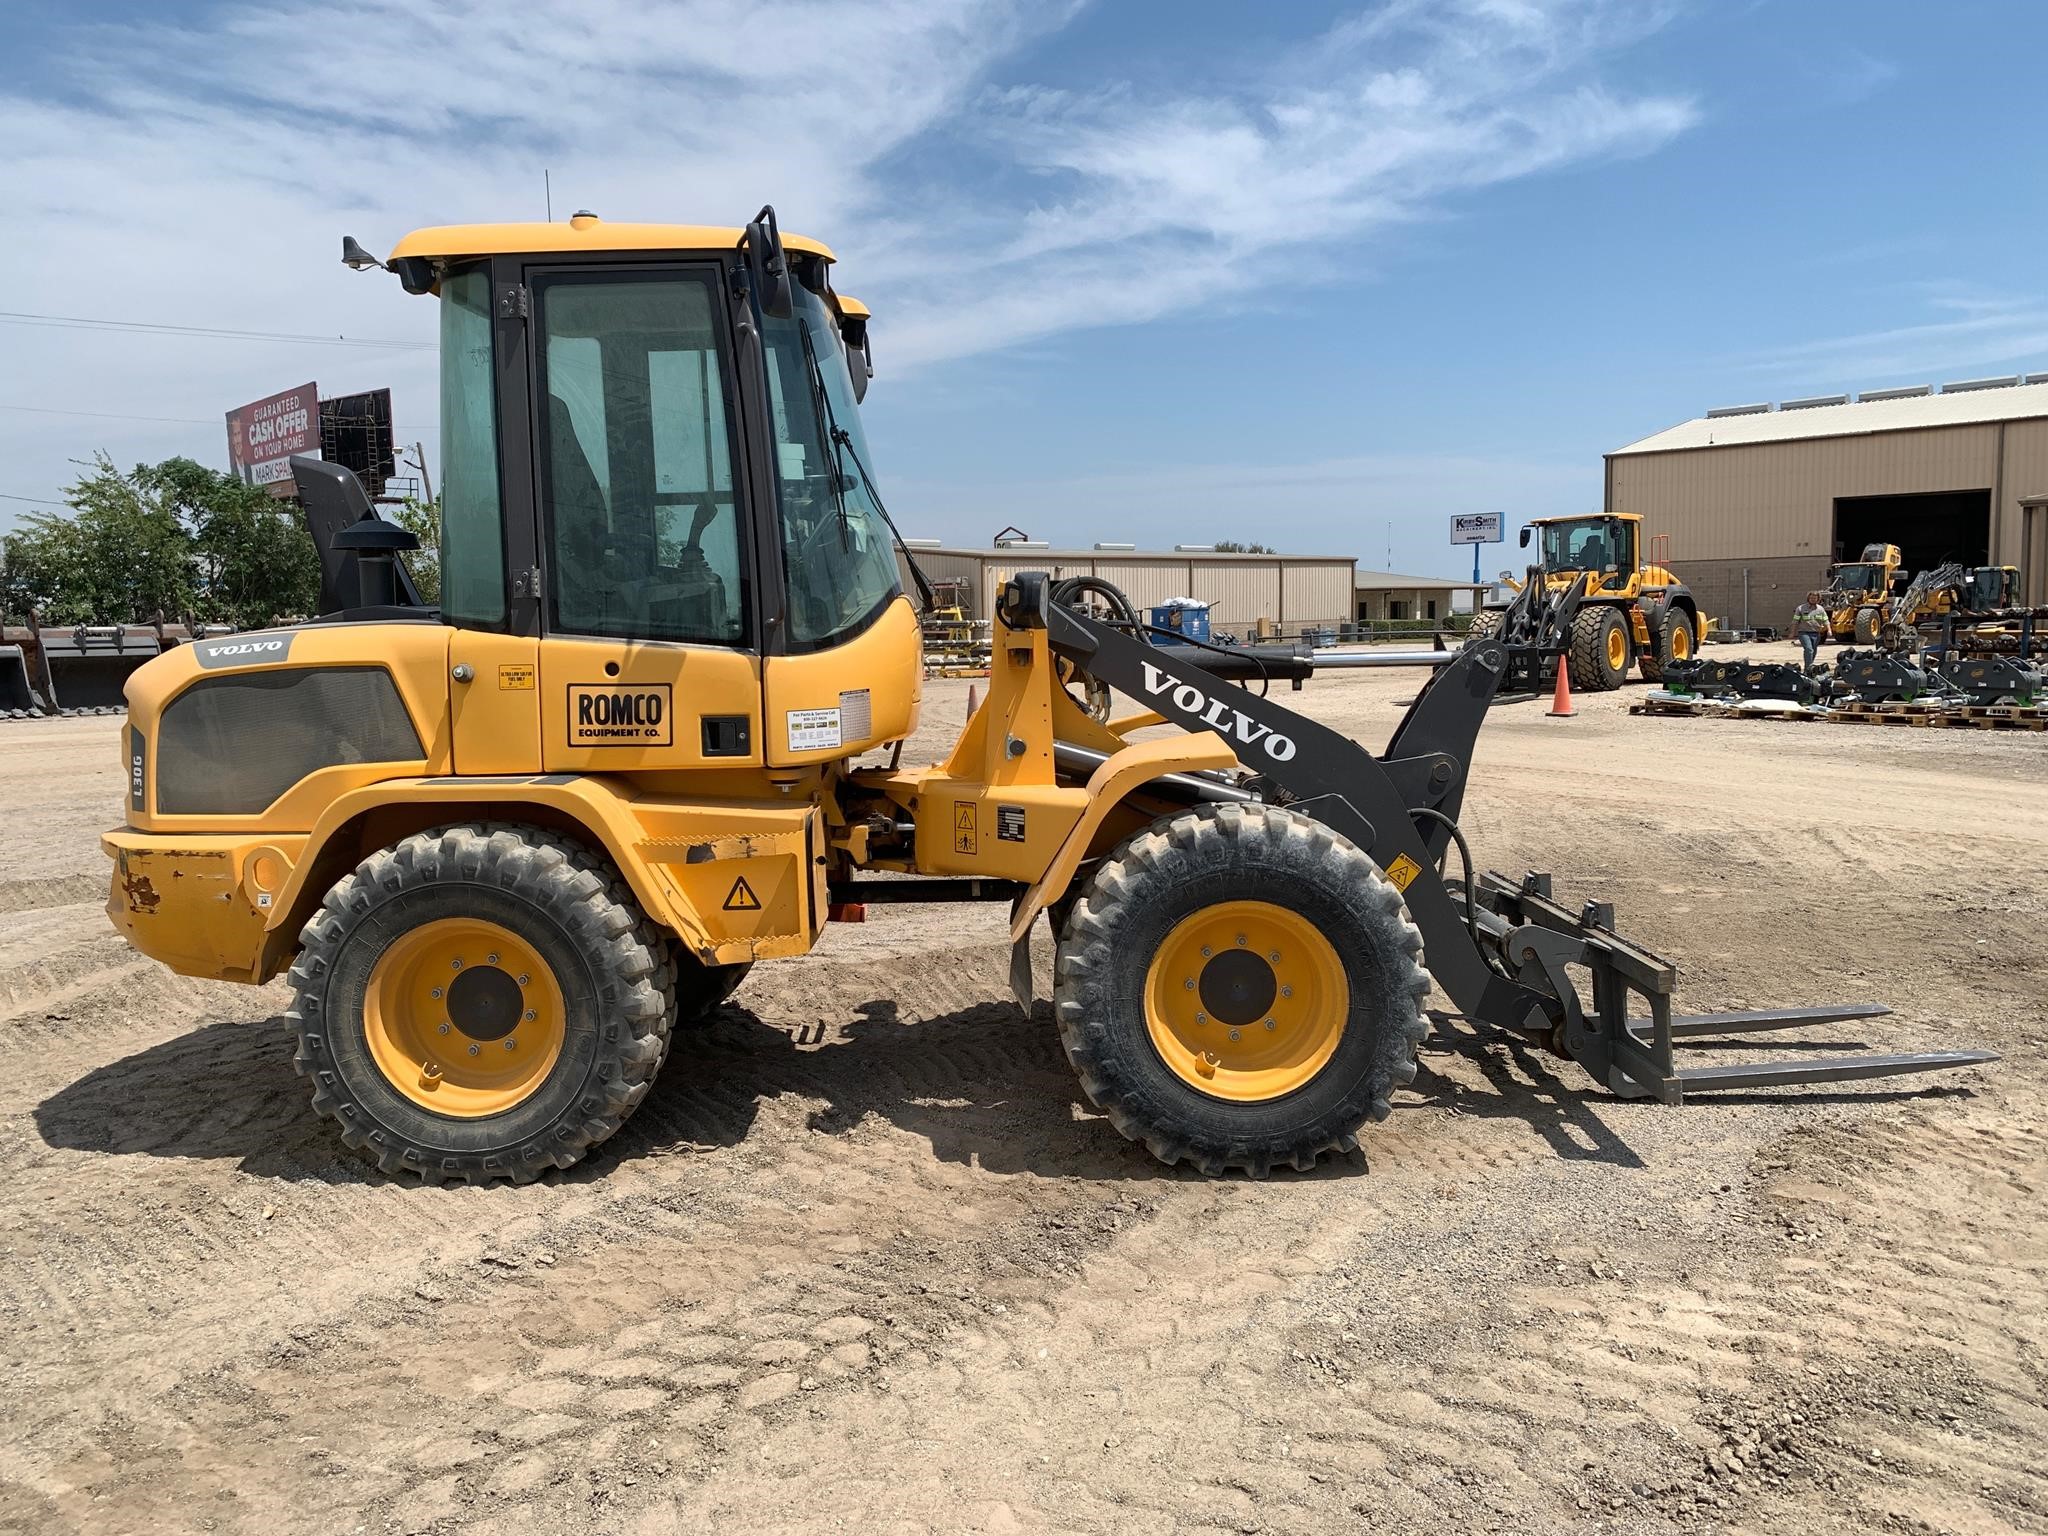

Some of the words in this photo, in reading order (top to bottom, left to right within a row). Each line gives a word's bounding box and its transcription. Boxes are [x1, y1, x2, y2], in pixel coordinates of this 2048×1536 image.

[254, 396, 300, 421] GUARANTEED
[249, 420, 275, 446] CASH
[275, 408, 309, 438] OFFER
[254, 446, 264, 459] ON
[265, 440, 282, 457] YOUR
[283, 434, 304, 450] HOME!
[255, 464, 275, 483] MARK
[207, 641, 284, 657] VOLVO
[579, 694, 662, 726] ROMCO
[1140, 660, 1297, 762] VOLVO
[579, 729, 640, 737] EQUIPMENT
[644, 729, 660, 737] CO.
[133, 755, 142, 797] L30G
